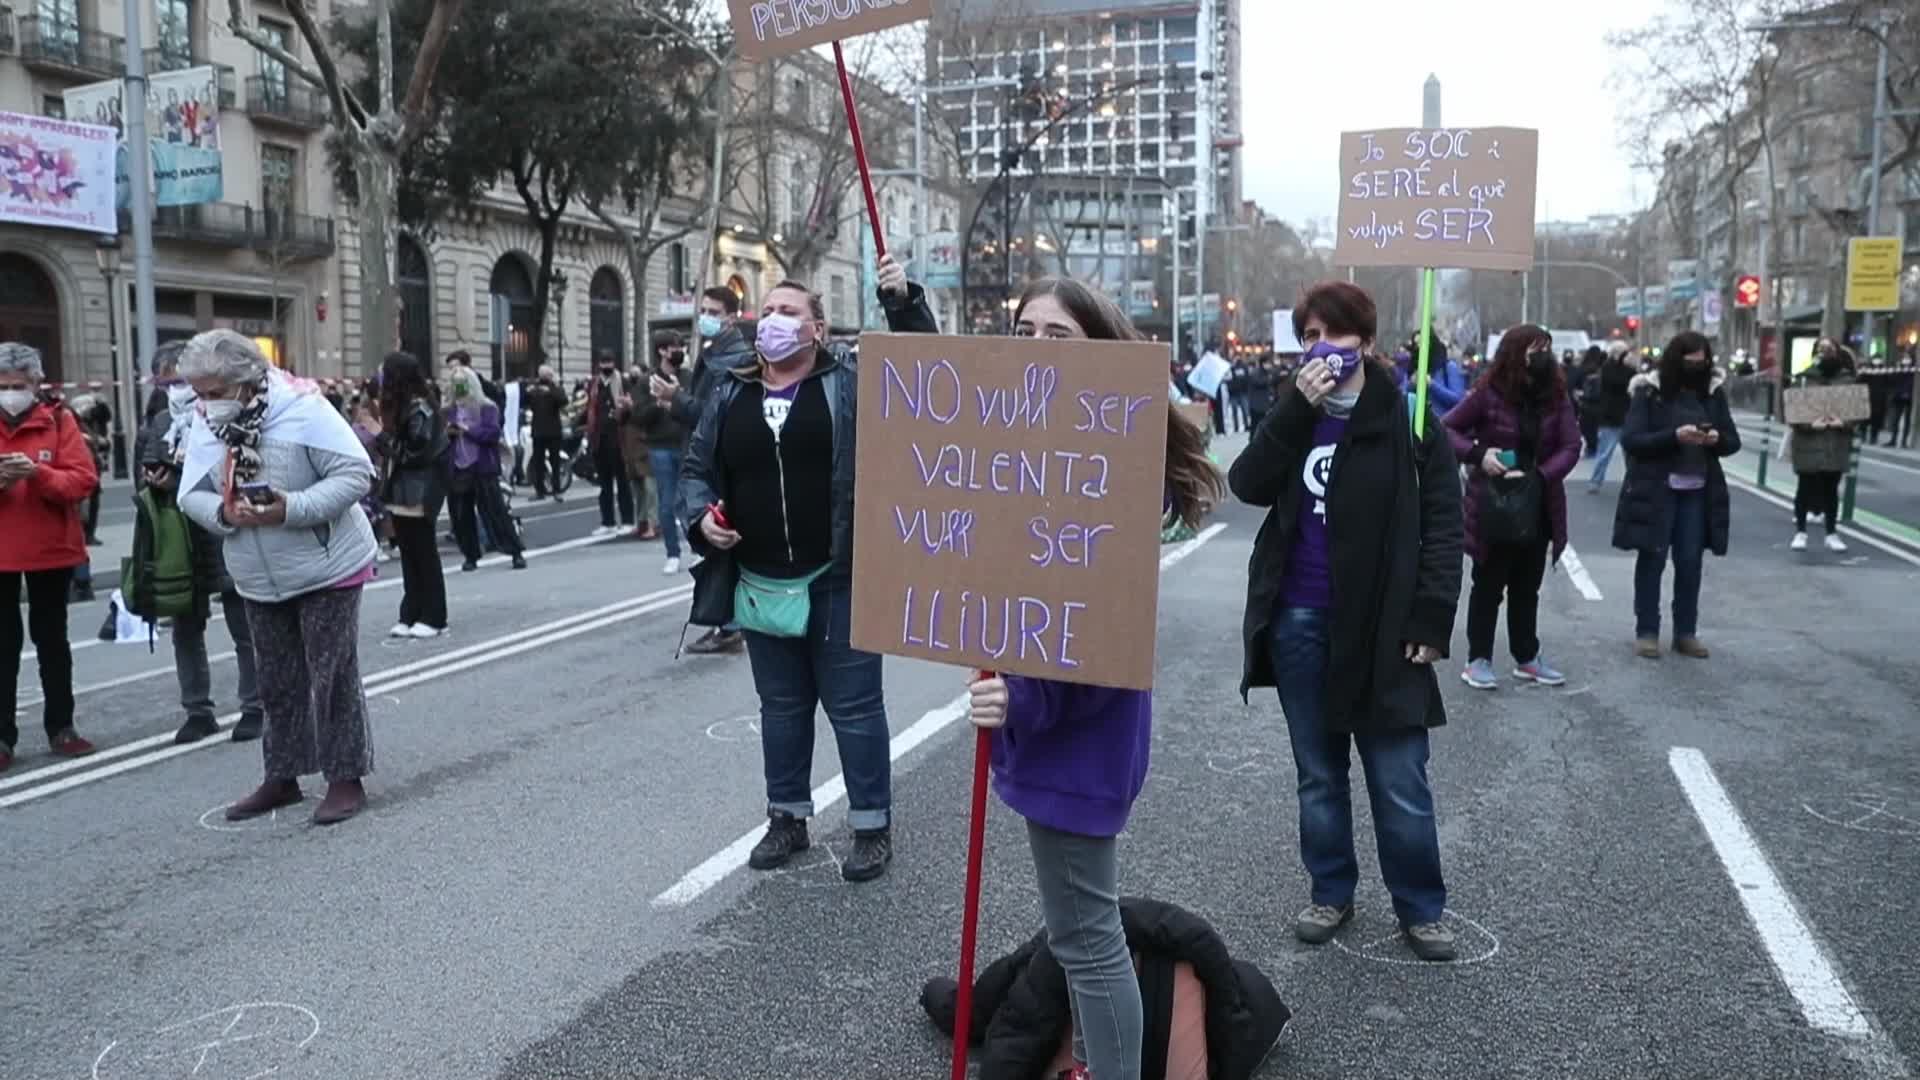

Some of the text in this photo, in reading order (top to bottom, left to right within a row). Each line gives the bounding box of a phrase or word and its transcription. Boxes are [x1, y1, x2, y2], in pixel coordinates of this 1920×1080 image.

[751, 0, 909, 41] PERSO
[1360, 134, 1384, 164] Jo
[1488, 141, 1500, 158] i
[1348, 160, 1432, 198] SERÉ
[1438, 169, 1460, 197] el
[1414, 208, 1494, 245] SER
[883, 358, 961, 424] NO
[1075, 391, 1152, 437] ser
